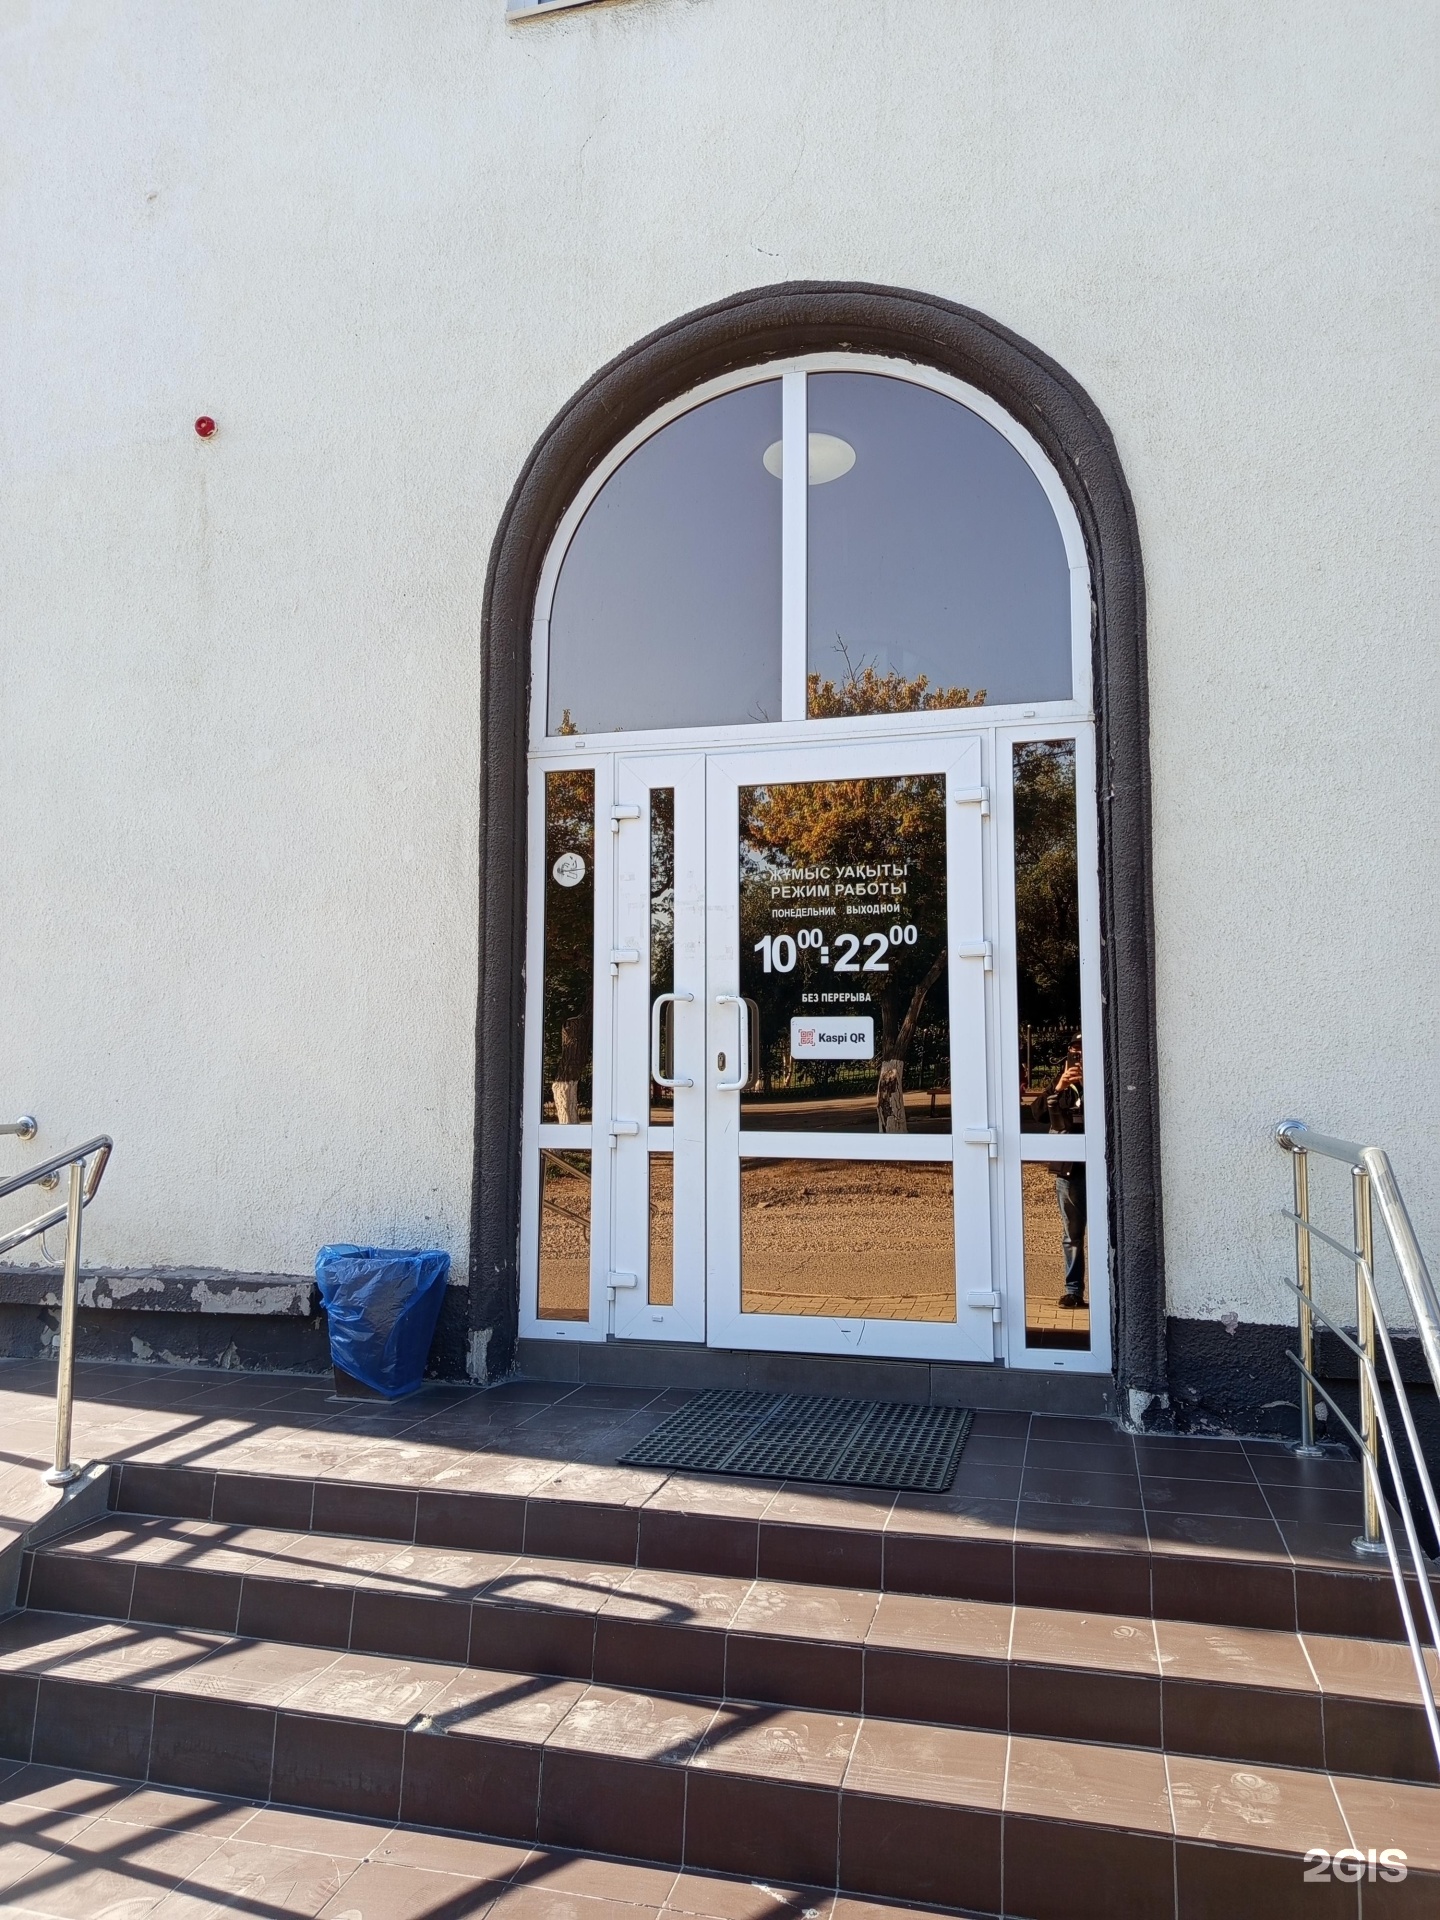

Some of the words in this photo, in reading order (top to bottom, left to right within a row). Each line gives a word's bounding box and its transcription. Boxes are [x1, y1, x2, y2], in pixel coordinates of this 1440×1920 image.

[836, 864, 908, 879] УАҚЫТЫ
[771, 885, 830, 899] РЕЖИМ
[835, 882, 907, 896] РАБОТЫ
[772, 906, 836, 918] ПОНЕДЕЛЬНИК
[801, 993, 819, 1003] БЕЗ
[821, 992, 872, 1003] ПЕРЕРЫВА
[818, 1032, 847, 1044] Kaspi
[849, 1033, 866, 1044] QR
